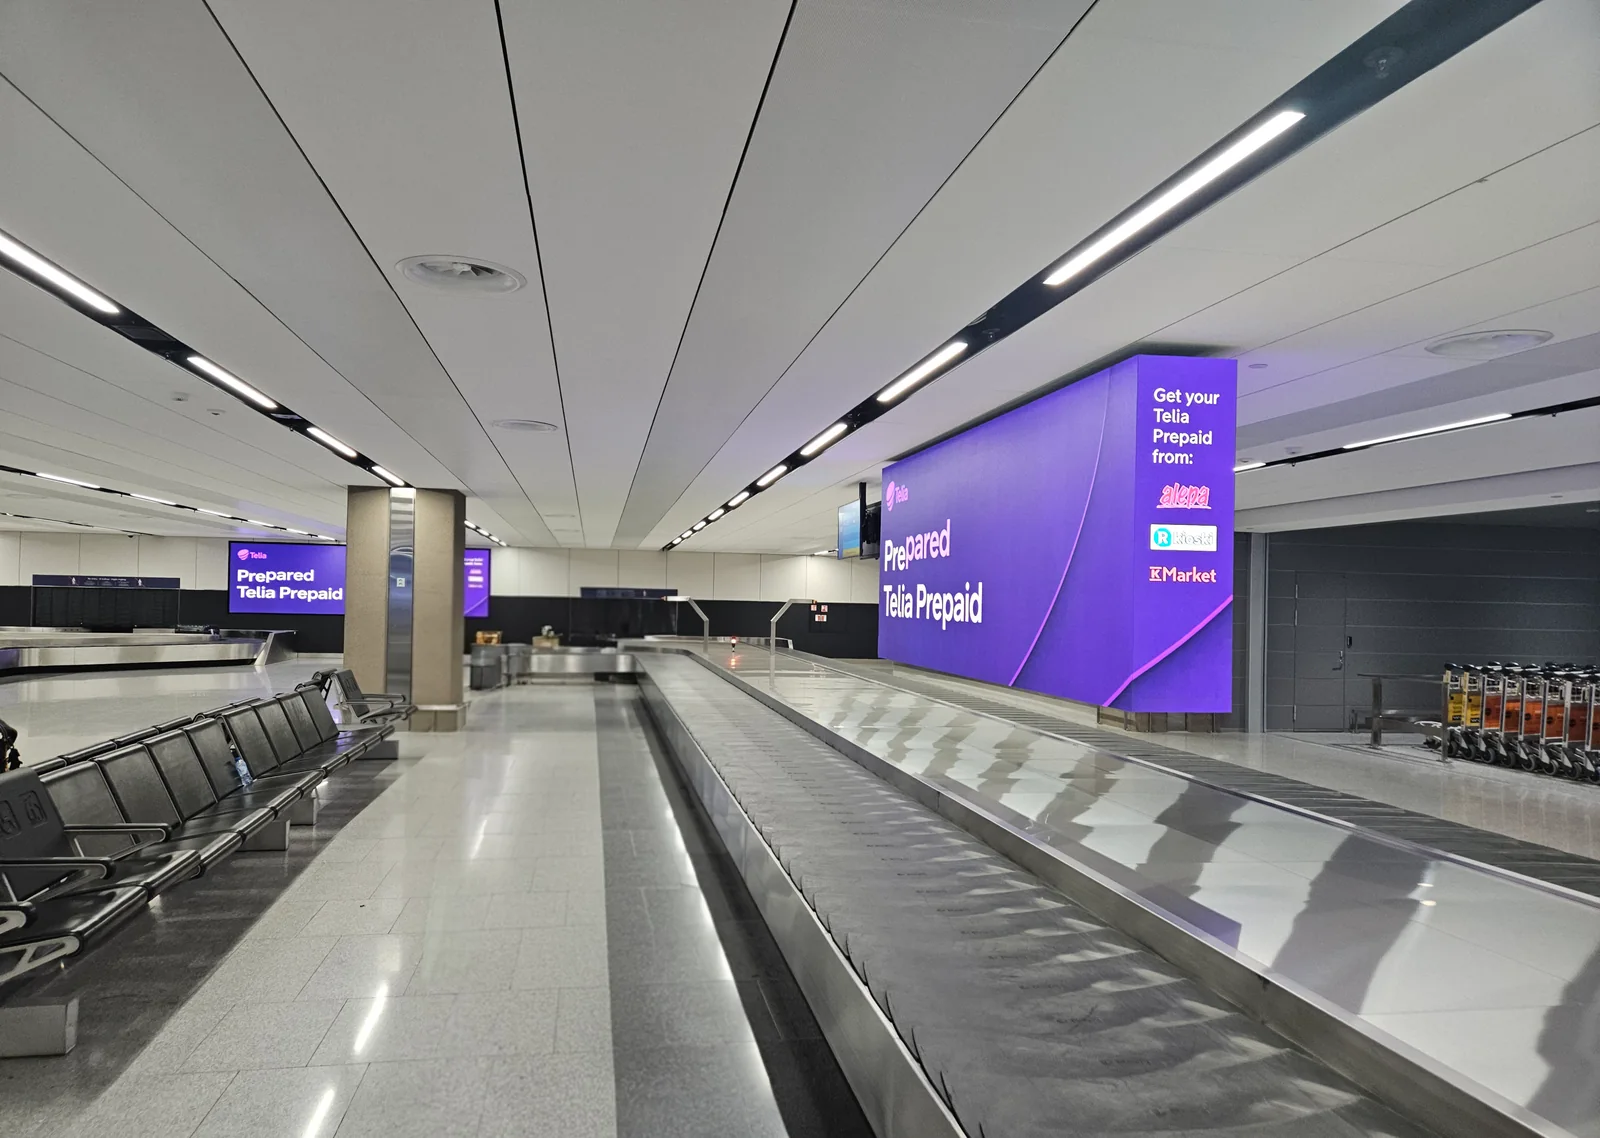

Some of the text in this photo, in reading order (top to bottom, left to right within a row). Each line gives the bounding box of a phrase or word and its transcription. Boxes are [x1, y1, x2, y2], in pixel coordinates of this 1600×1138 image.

[1153, 387, 1220, 407] Get your
[1153, 408, 1190, 424] Telia
[1153, 428, 1213, 448] Prepaid
[1152, 449, 1193, 465] from:
[894, 484, 909, 503] Telia
[1158, 483, 1211, 508] alepa
[884, 518, 951, 572] Prepared
[249, 551, 267, 559] Telia
[237, 569, 315, 583] Prepared
[236, 585, 343, 602] Telia Prepaid
[883, 581, 983, 631] Telia Prepaid
